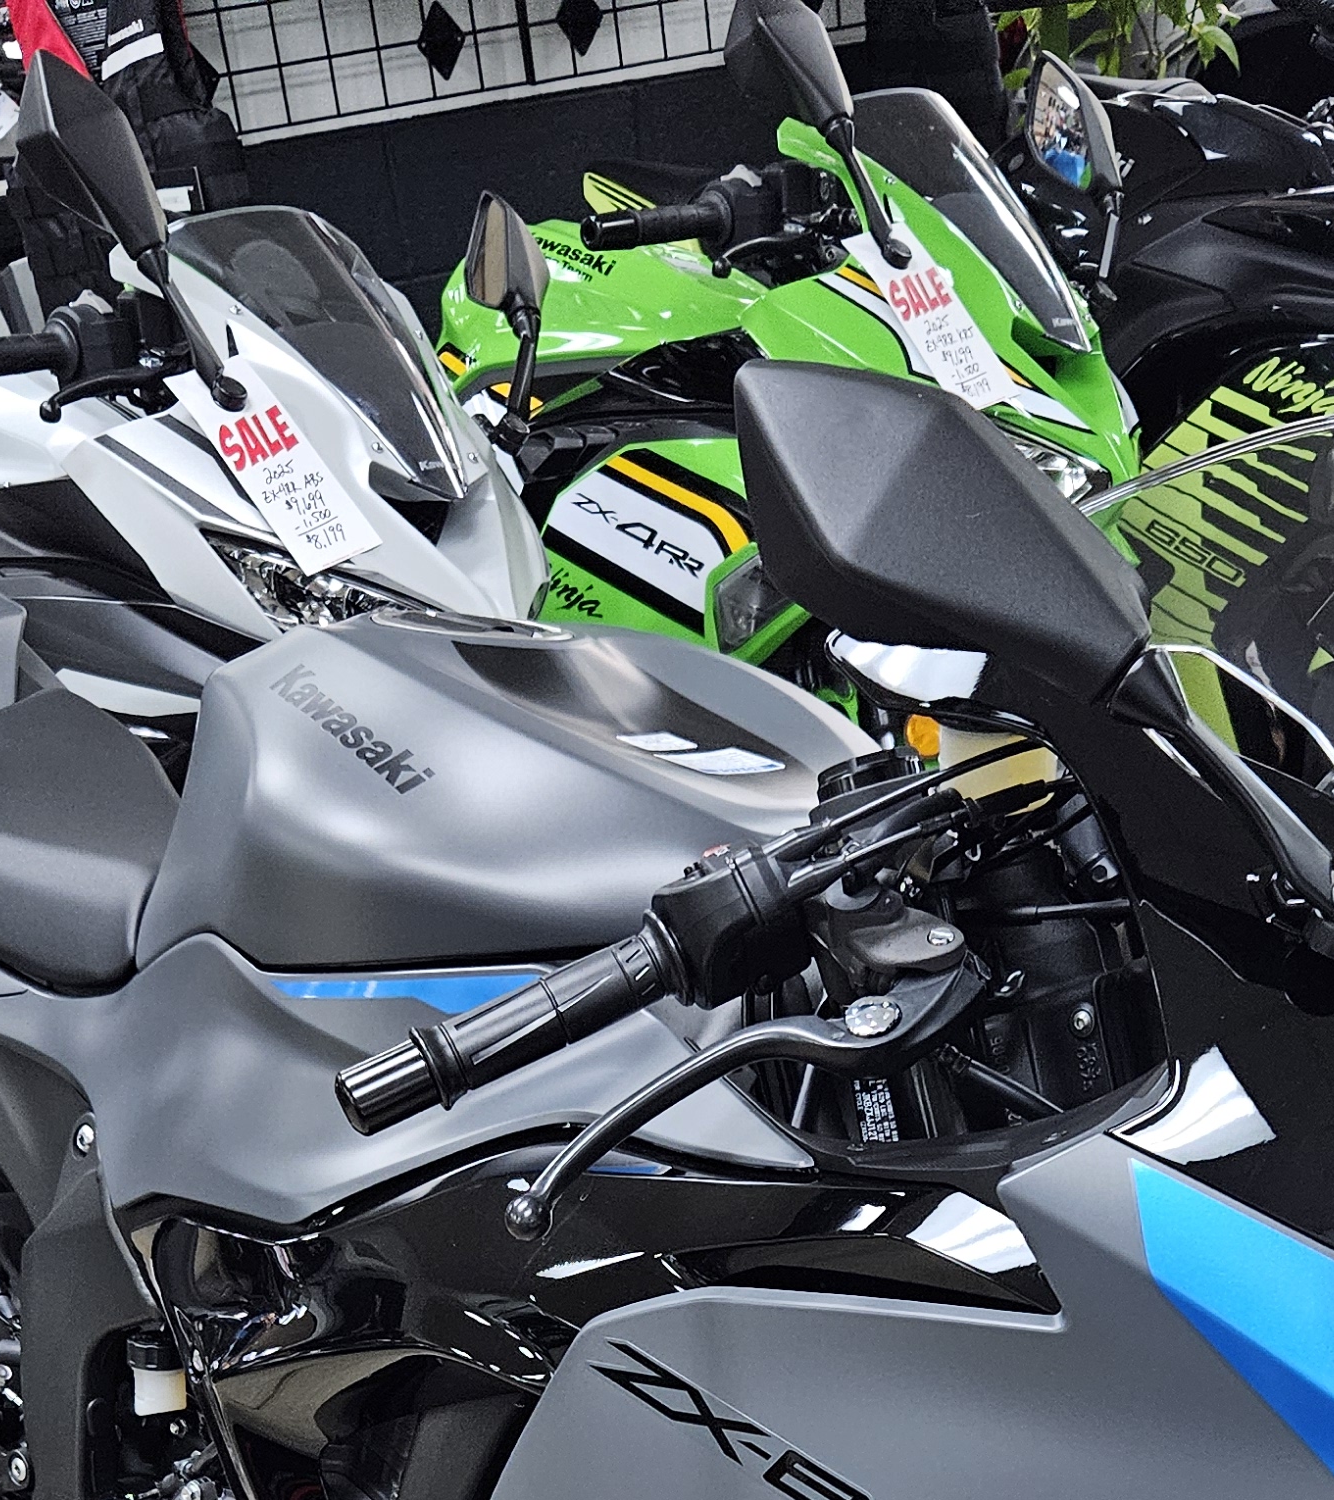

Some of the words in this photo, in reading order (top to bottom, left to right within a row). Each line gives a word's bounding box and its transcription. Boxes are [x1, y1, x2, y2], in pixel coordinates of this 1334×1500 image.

[532, 232, 617, 276] awasaki
[889, 266, 953, 322] SALE
[219, 404, 300, 472] SALE
[262, 459, 294, 485] 2025
[303, 471, 324, 489] ABS
[285, 489, 326, 515] $9,699
[305, 523, 347, 549] $8,199
[571, 492, 705, 579] ZX-4RR
[1145, 519, 1244, 582] 650
[269, 663, 436, 795] Kawasaki
